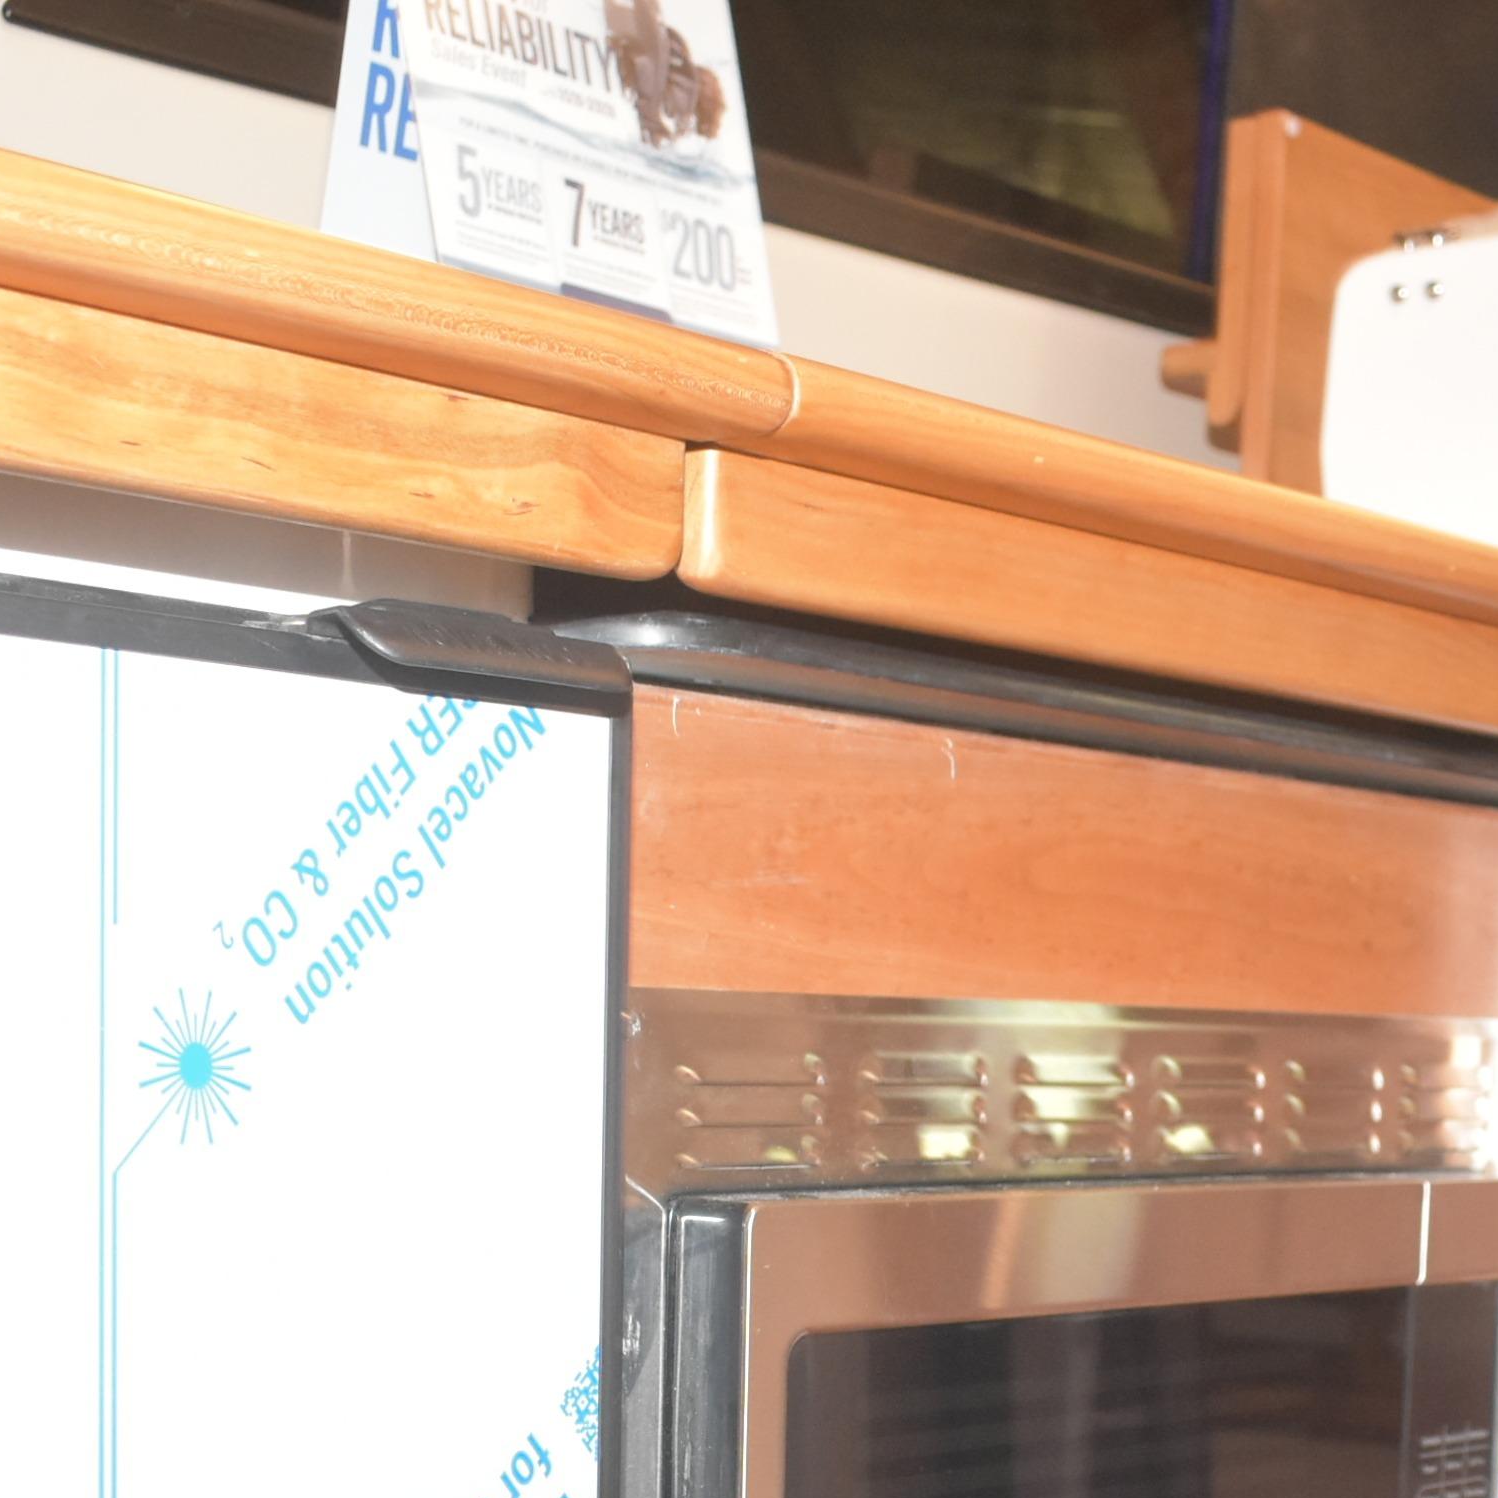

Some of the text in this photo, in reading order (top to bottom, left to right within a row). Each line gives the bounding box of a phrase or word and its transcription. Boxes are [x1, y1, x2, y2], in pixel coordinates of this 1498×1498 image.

[424, 0, 615, 94] RELIABILITY
[456, 144, 482, 218] 5
[481, 165, 544, 215] YEARS
[563, 177, 585, 247] 7
[588, 198, 645, 245] YEARS
[326, 739, 418, 857] Fiber
[284, 706, 547, 1025] Novacel Solution
[290, 848, 330, 897] &
